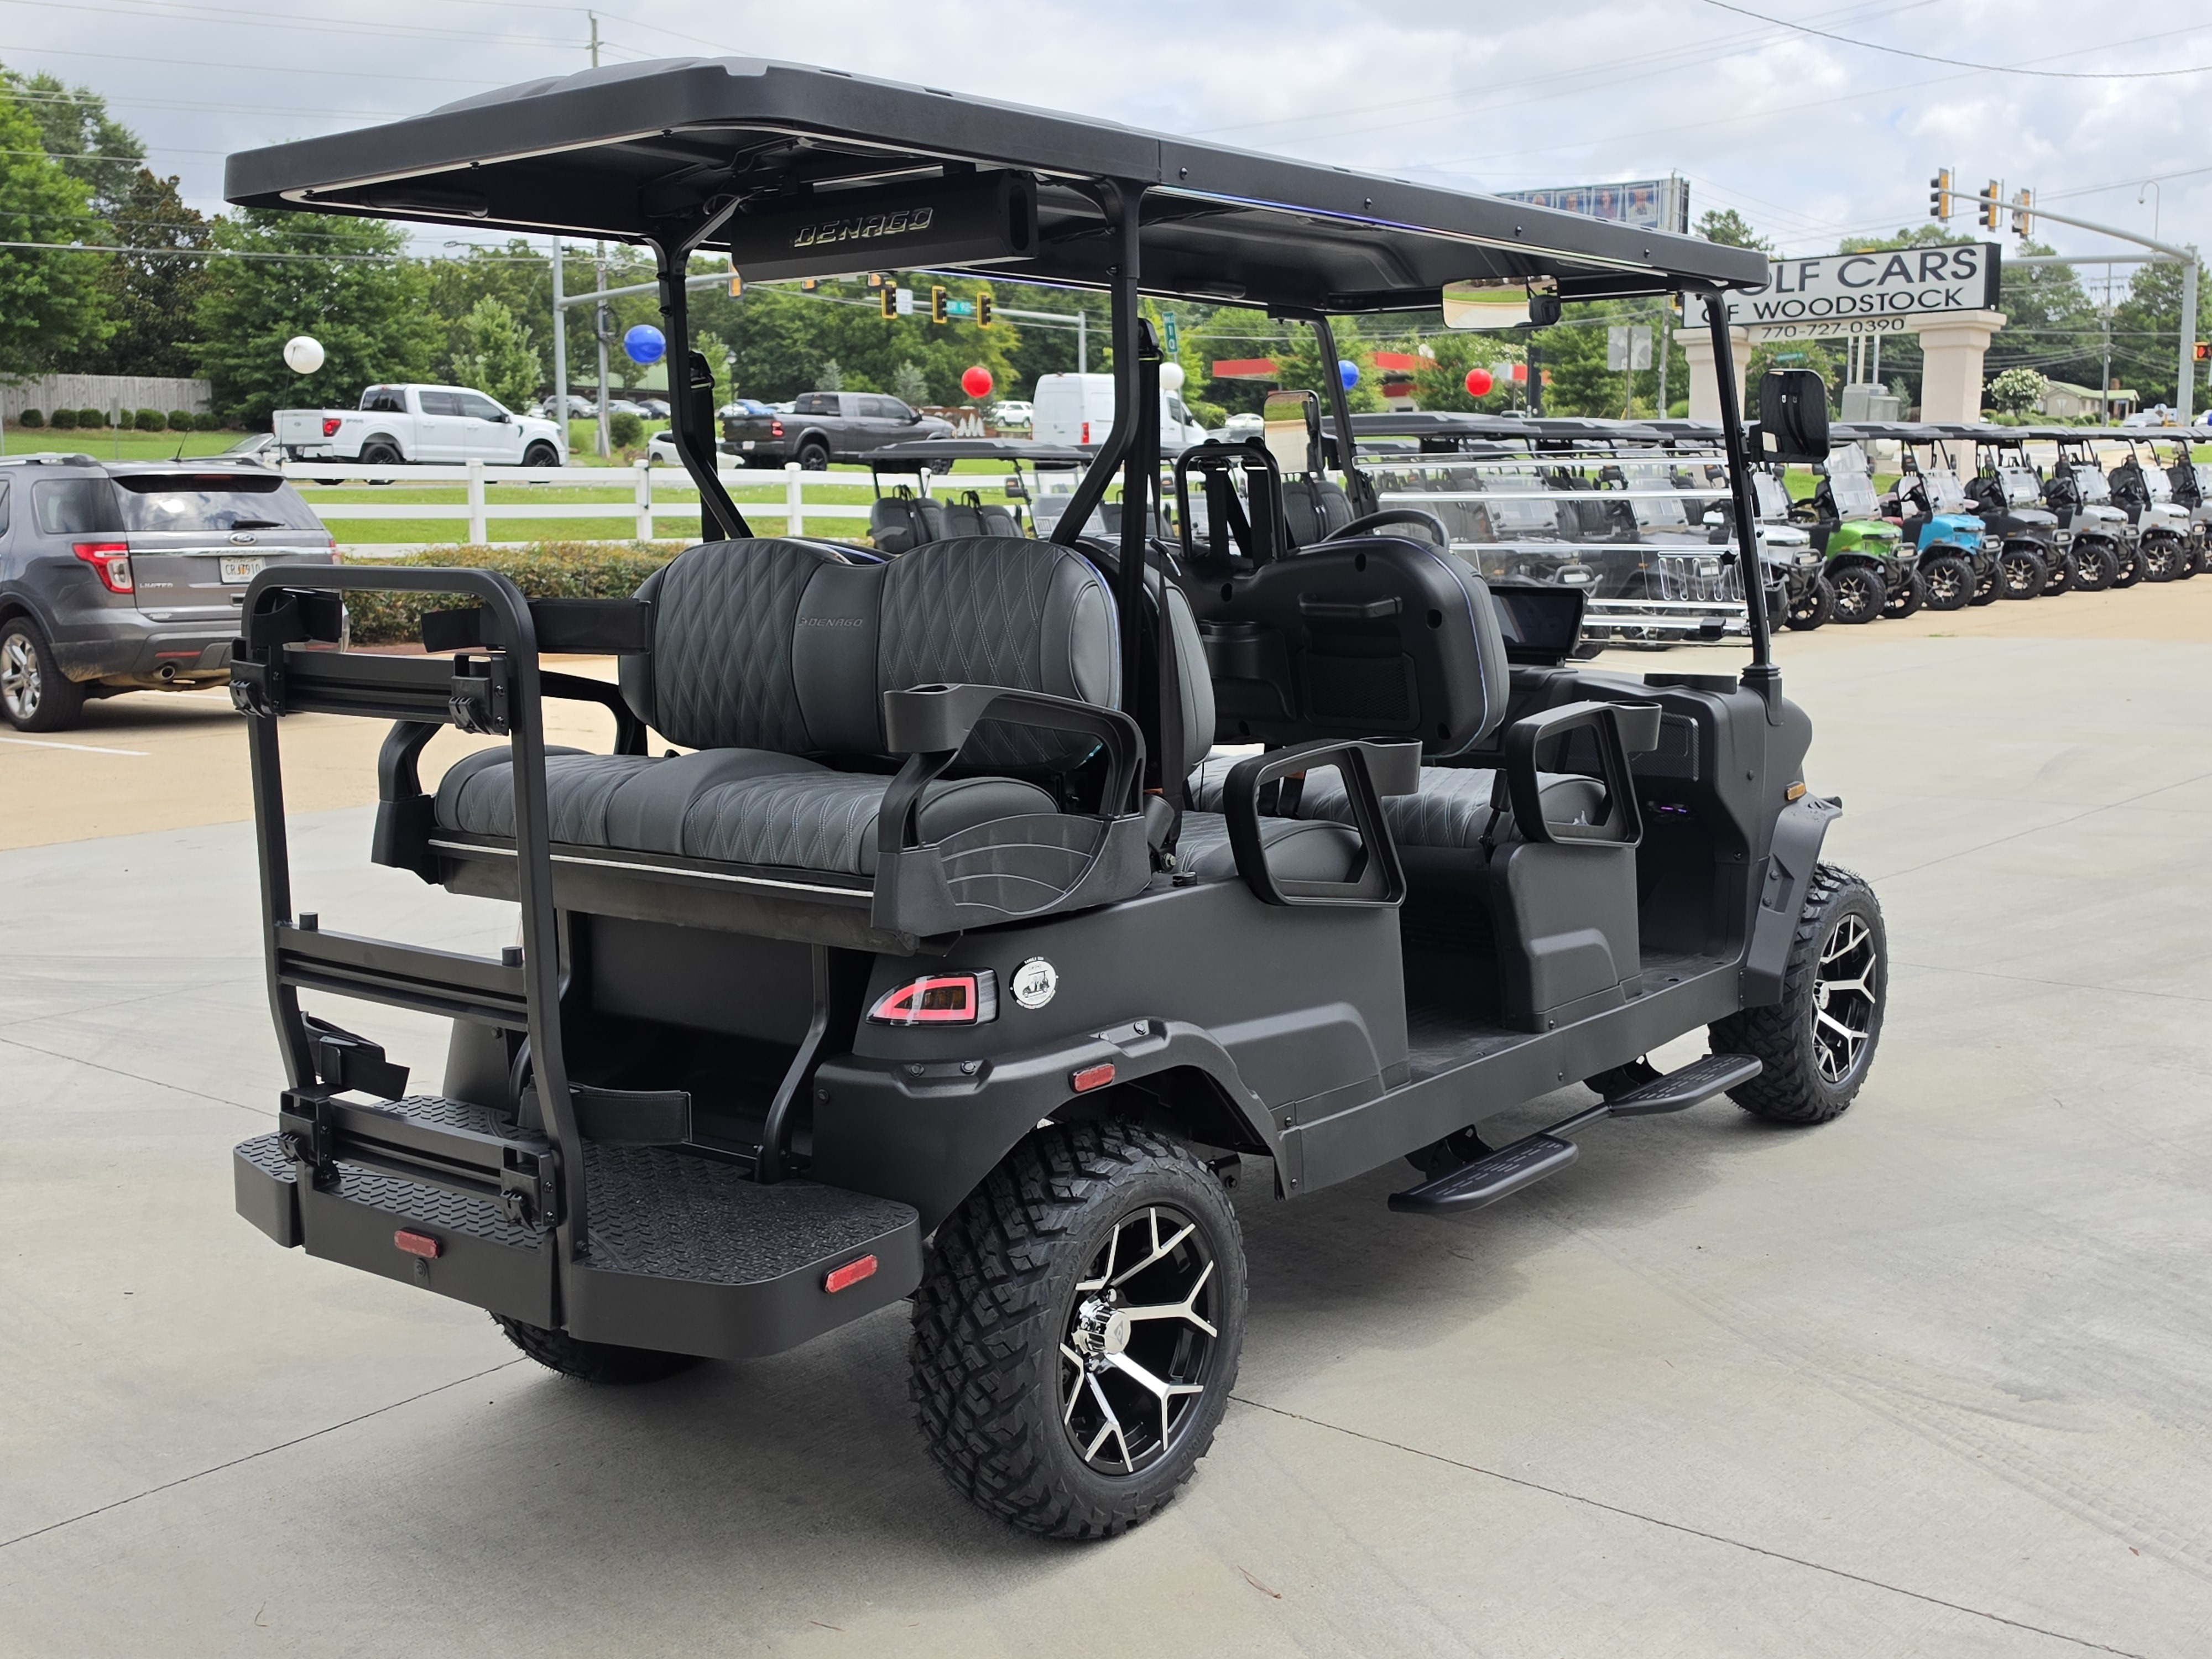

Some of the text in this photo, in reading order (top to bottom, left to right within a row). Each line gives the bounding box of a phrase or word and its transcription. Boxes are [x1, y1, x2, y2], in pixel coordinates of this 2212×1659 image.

[794, 207, 933, 248] DENAGO
[1721, 248, 1977, 296] LF CARS
[1752, 286, 1964, 320] WOODSTOCK
[1761, 318, 1905, 339] 770-727-0390
[808, 618, 863, 627] DENAGO
